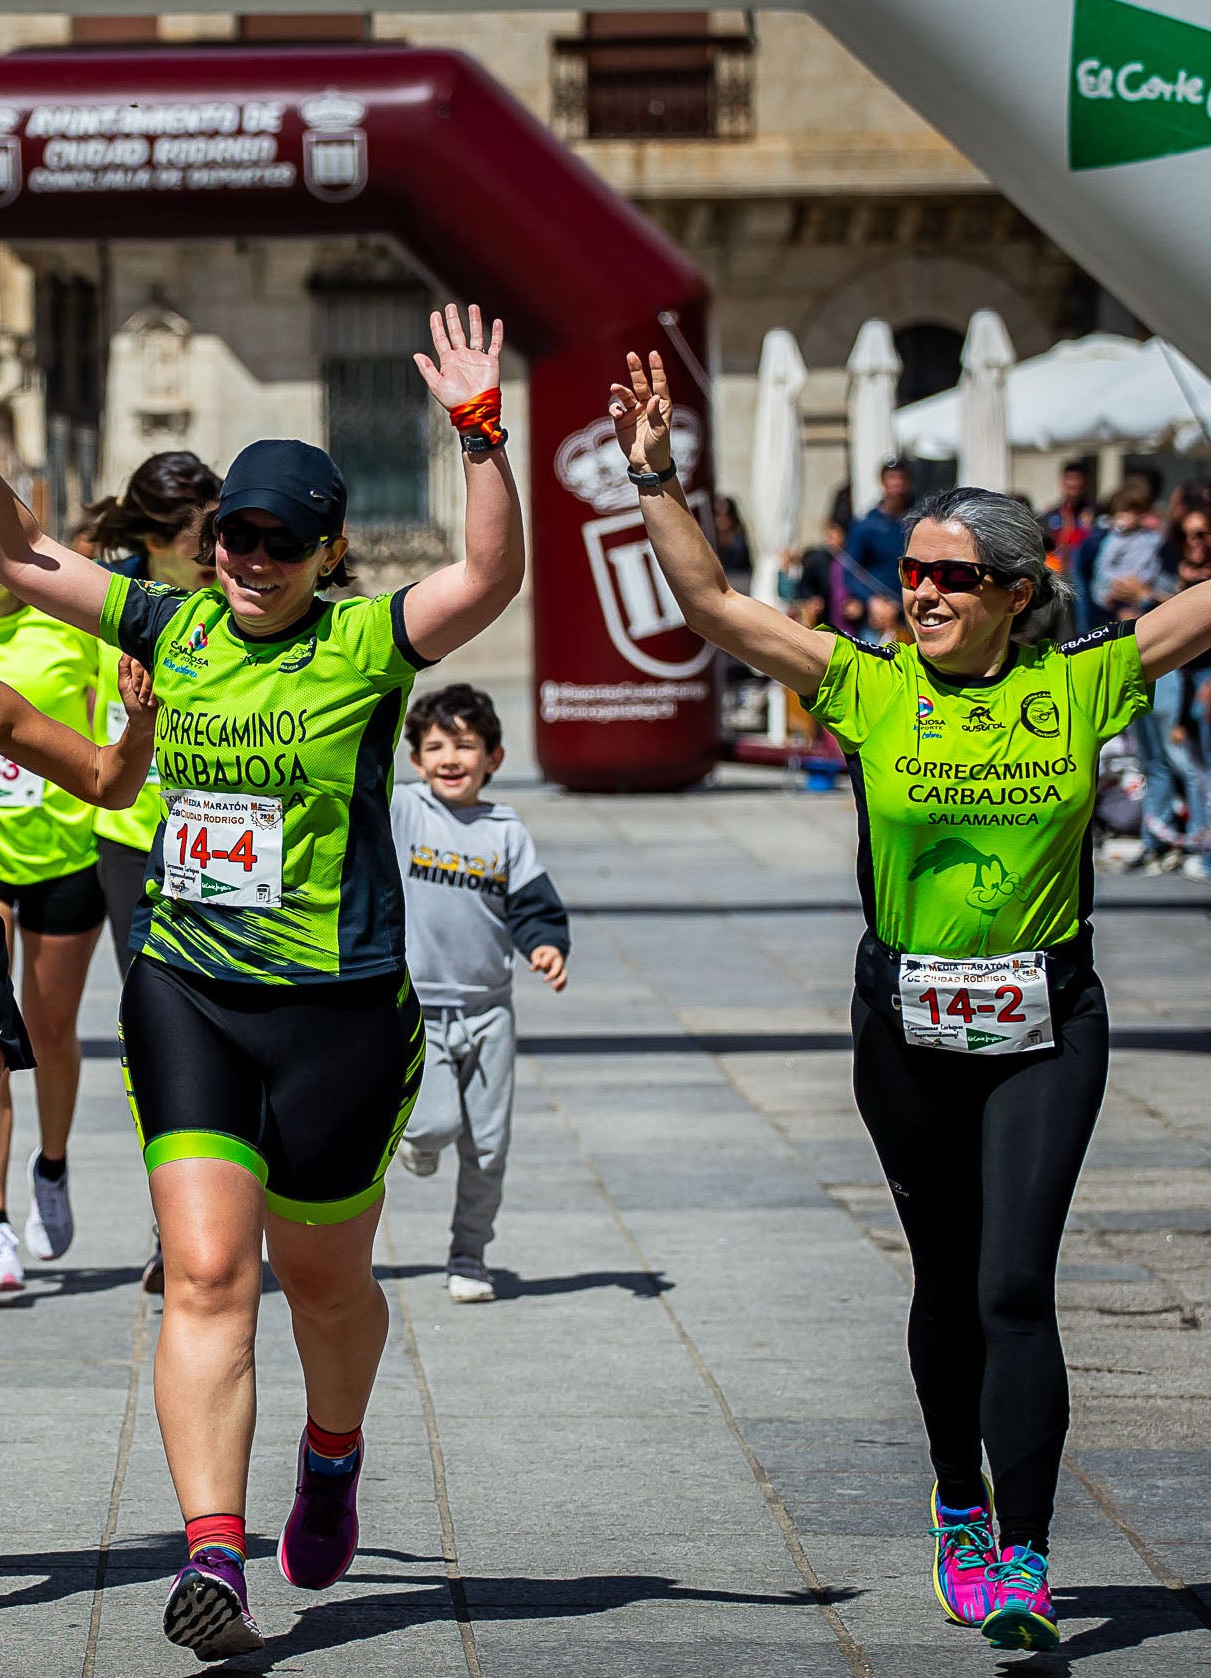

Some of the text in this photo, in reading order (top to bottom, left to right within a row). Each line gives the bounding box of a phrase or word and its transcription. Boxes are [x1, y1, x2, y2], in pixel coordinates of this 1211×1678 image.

[1076, 58, 1204, 105] El Corte
[155, 746, 309, 788] CARBAJOSA
[894, 753, 1078, 781] CORRECAMINOS
[183, 796, 201, 808] MEDIA
[203, 800, 248, 812] MARATÓN
[907, 784, 1063, 806] CARBAJOSA
[180, 809, 202, 821] CIUDAD
[203, 813, 245, 825] RODRIGO
[927, 812, 1040, 826] SALAMANCA
[176, 822, 258, 872] 14-4
[409, 861, 507, 896] MINIONS
[923, 974, 961, 983] CIUDAD
[963, 974, 1007, 984] RODRIGO
[929, 963, 960, 972] MEDIA
[961, 961, 1010, 971] MARATÓN
[918, 985, 1027, 1025] 14-2
